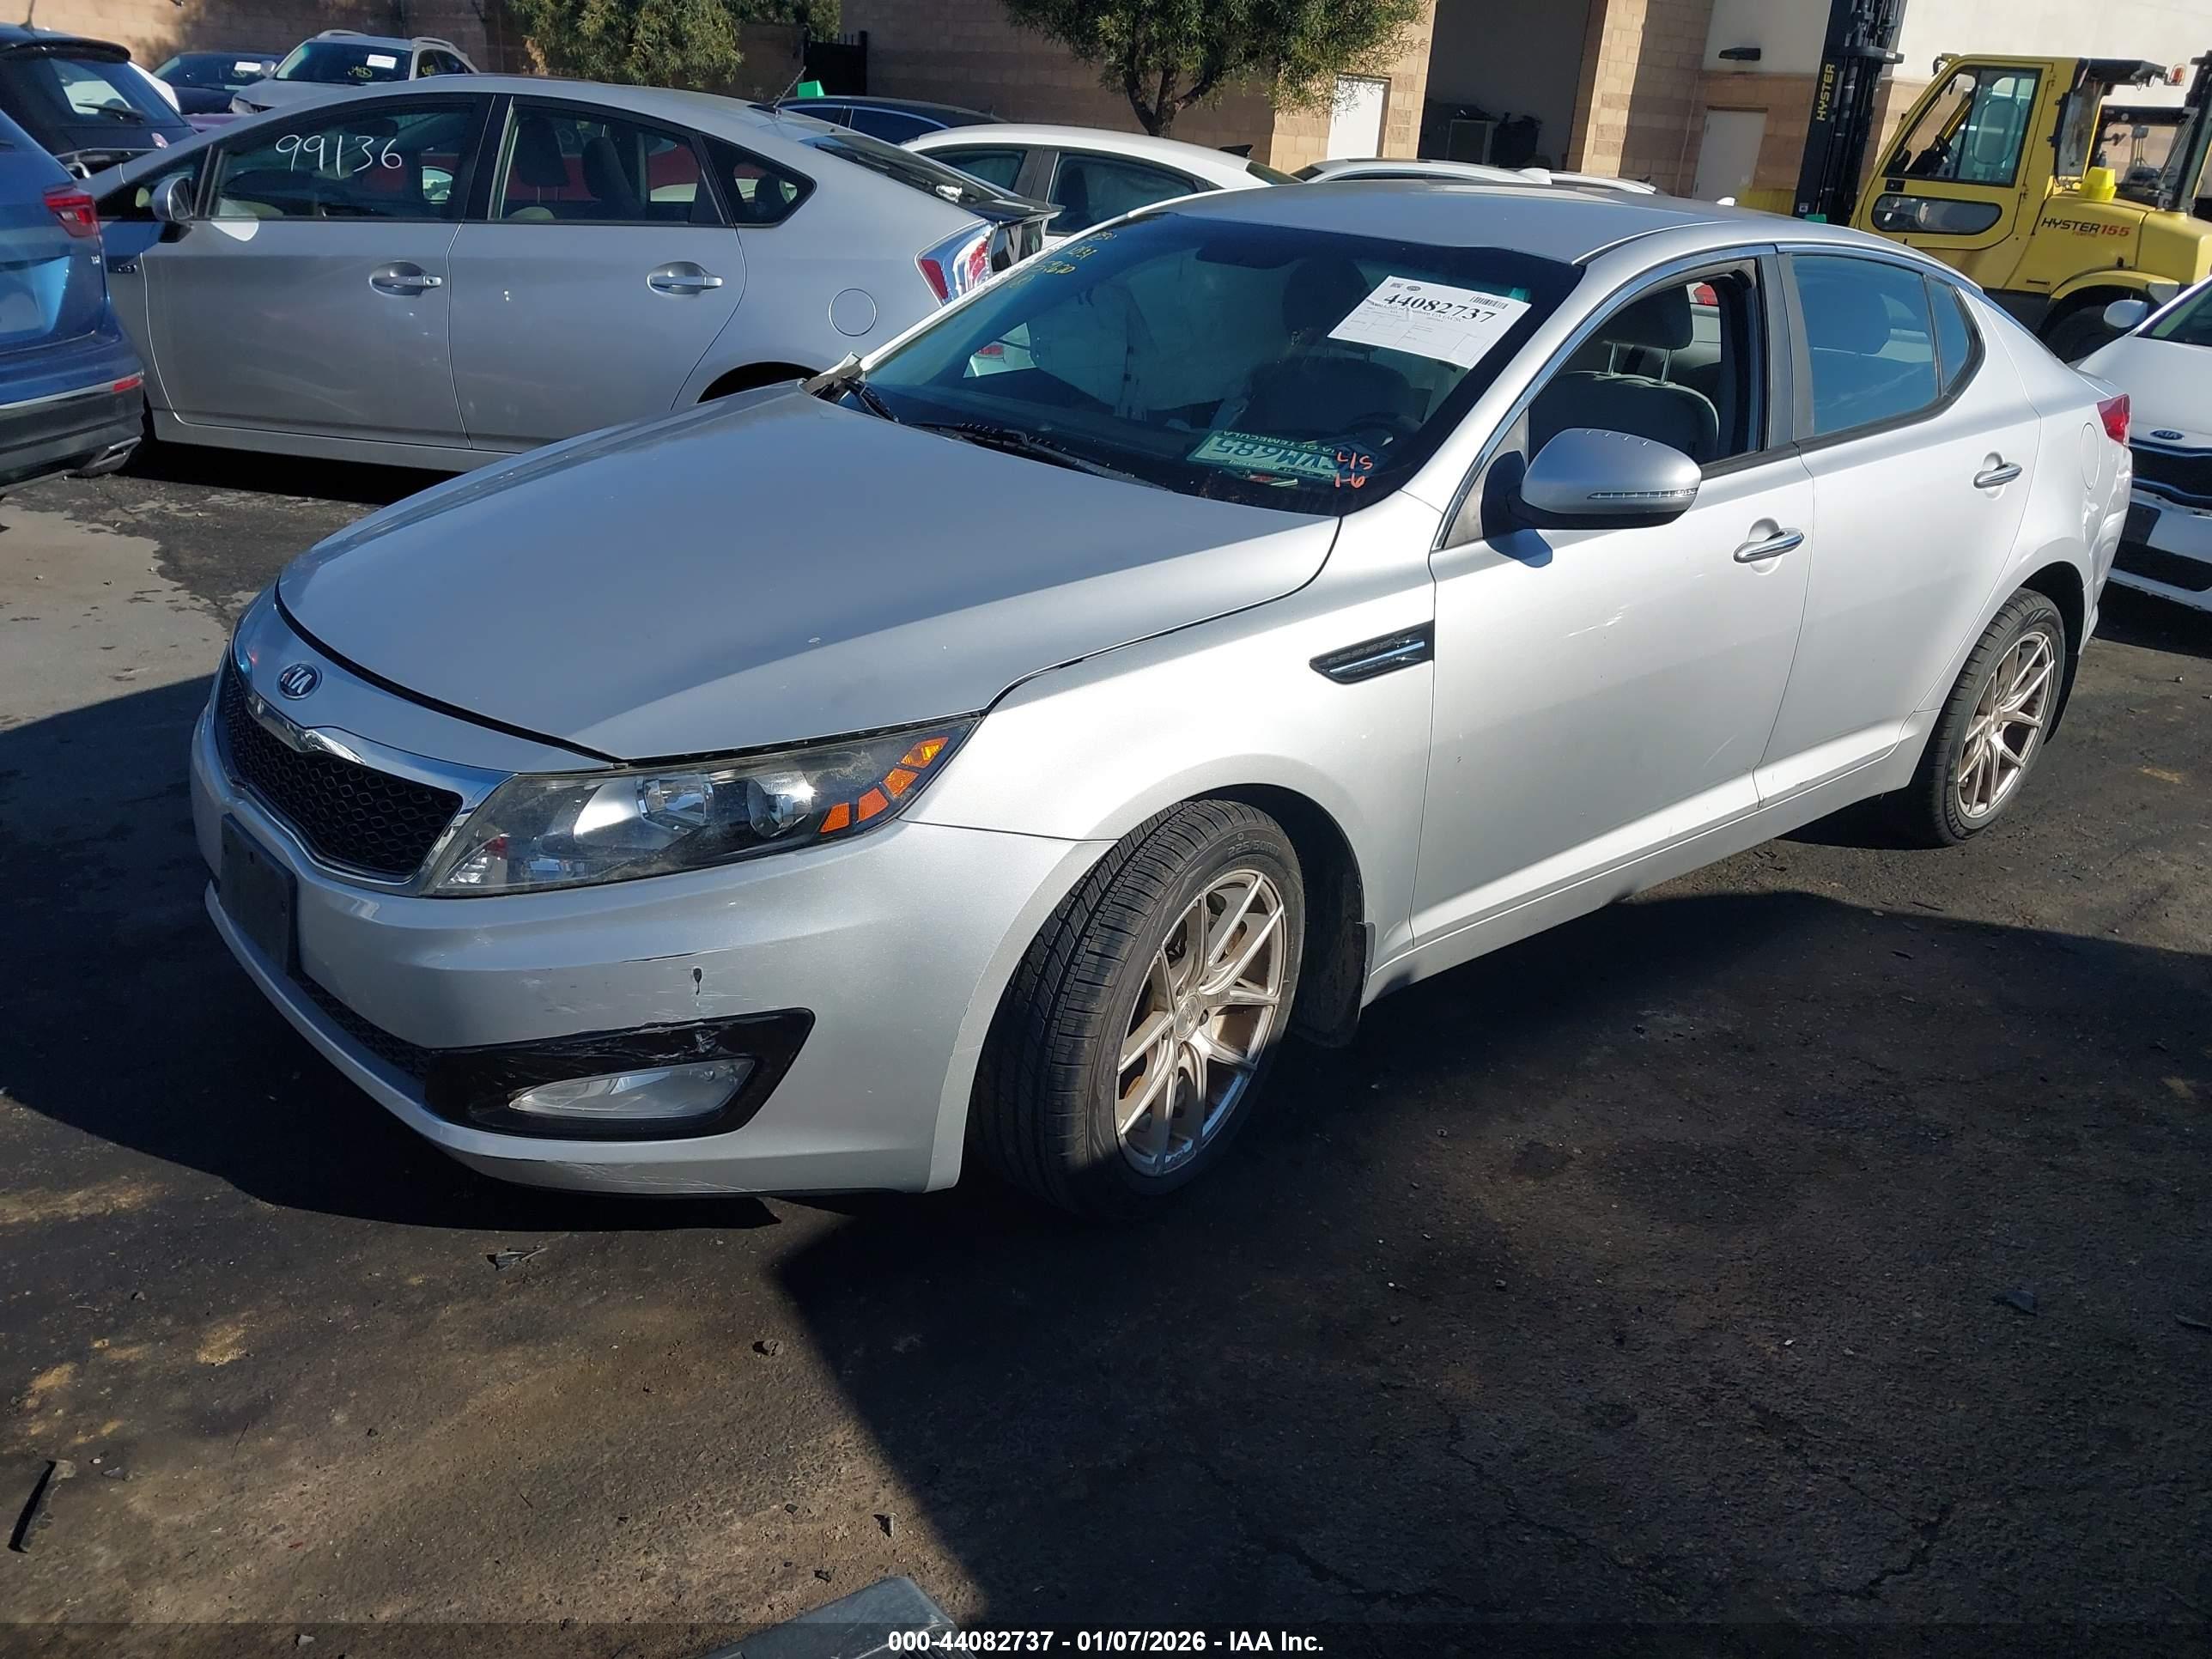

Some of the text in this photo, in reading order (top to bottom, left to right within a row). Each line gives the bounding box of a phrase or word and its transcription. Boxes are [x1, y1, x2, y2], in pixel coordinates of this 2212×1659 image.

[1816, 64, 1835, 121] HYSTER
[276, 134, 403, 179] 99136
[1383, 293, 1498, 323] 44082737
[1223, 430, 1297, 447] TEMECULA
[280, 666, 313, 694] KIA
